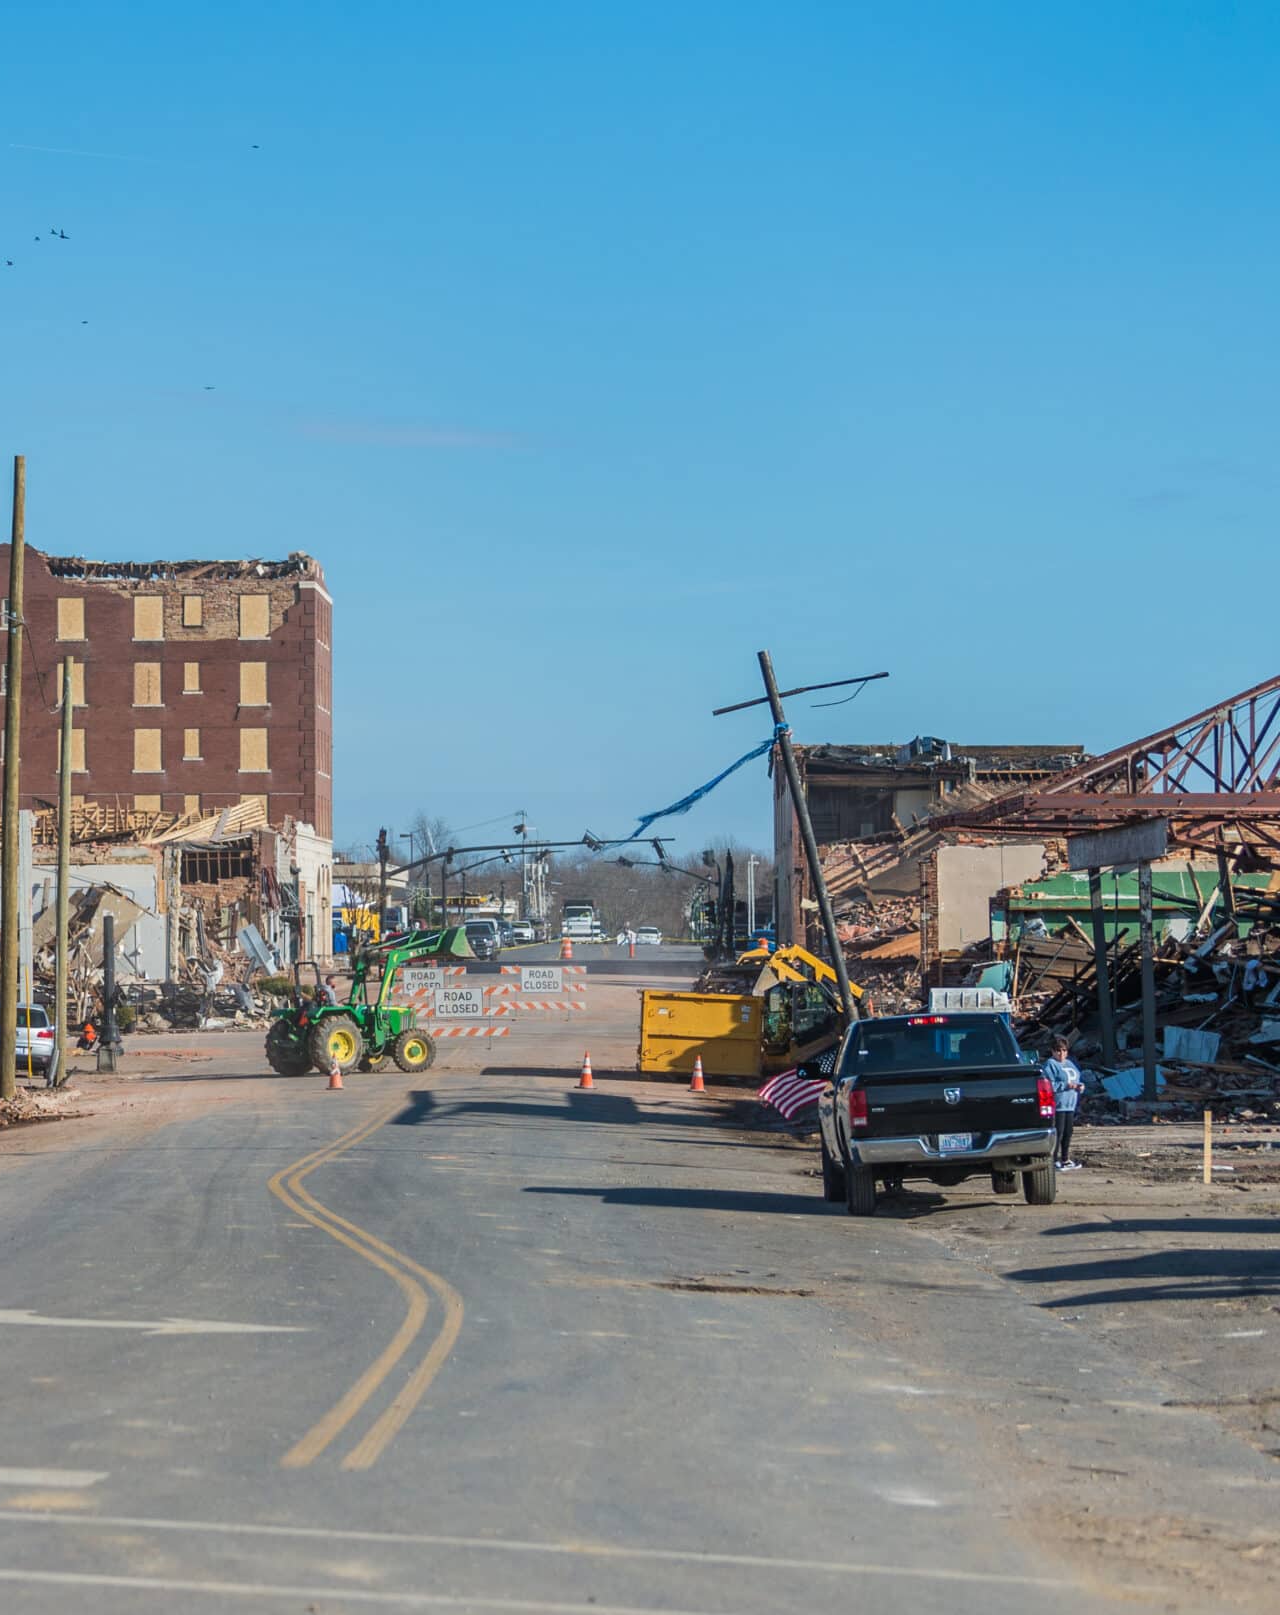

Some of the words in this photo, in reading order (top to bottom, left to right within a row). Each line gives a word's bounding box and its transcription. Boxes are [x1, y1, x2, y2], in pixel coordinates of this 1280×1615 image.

[410, 971, 436, 980] ROAD
[528, 970, 554, 978] ROAD
[523, 981, 559, 990] CLOSED
[443, 991, 473, 1001] ROAD
[438, 1004, 479, 1014] CLOSED
